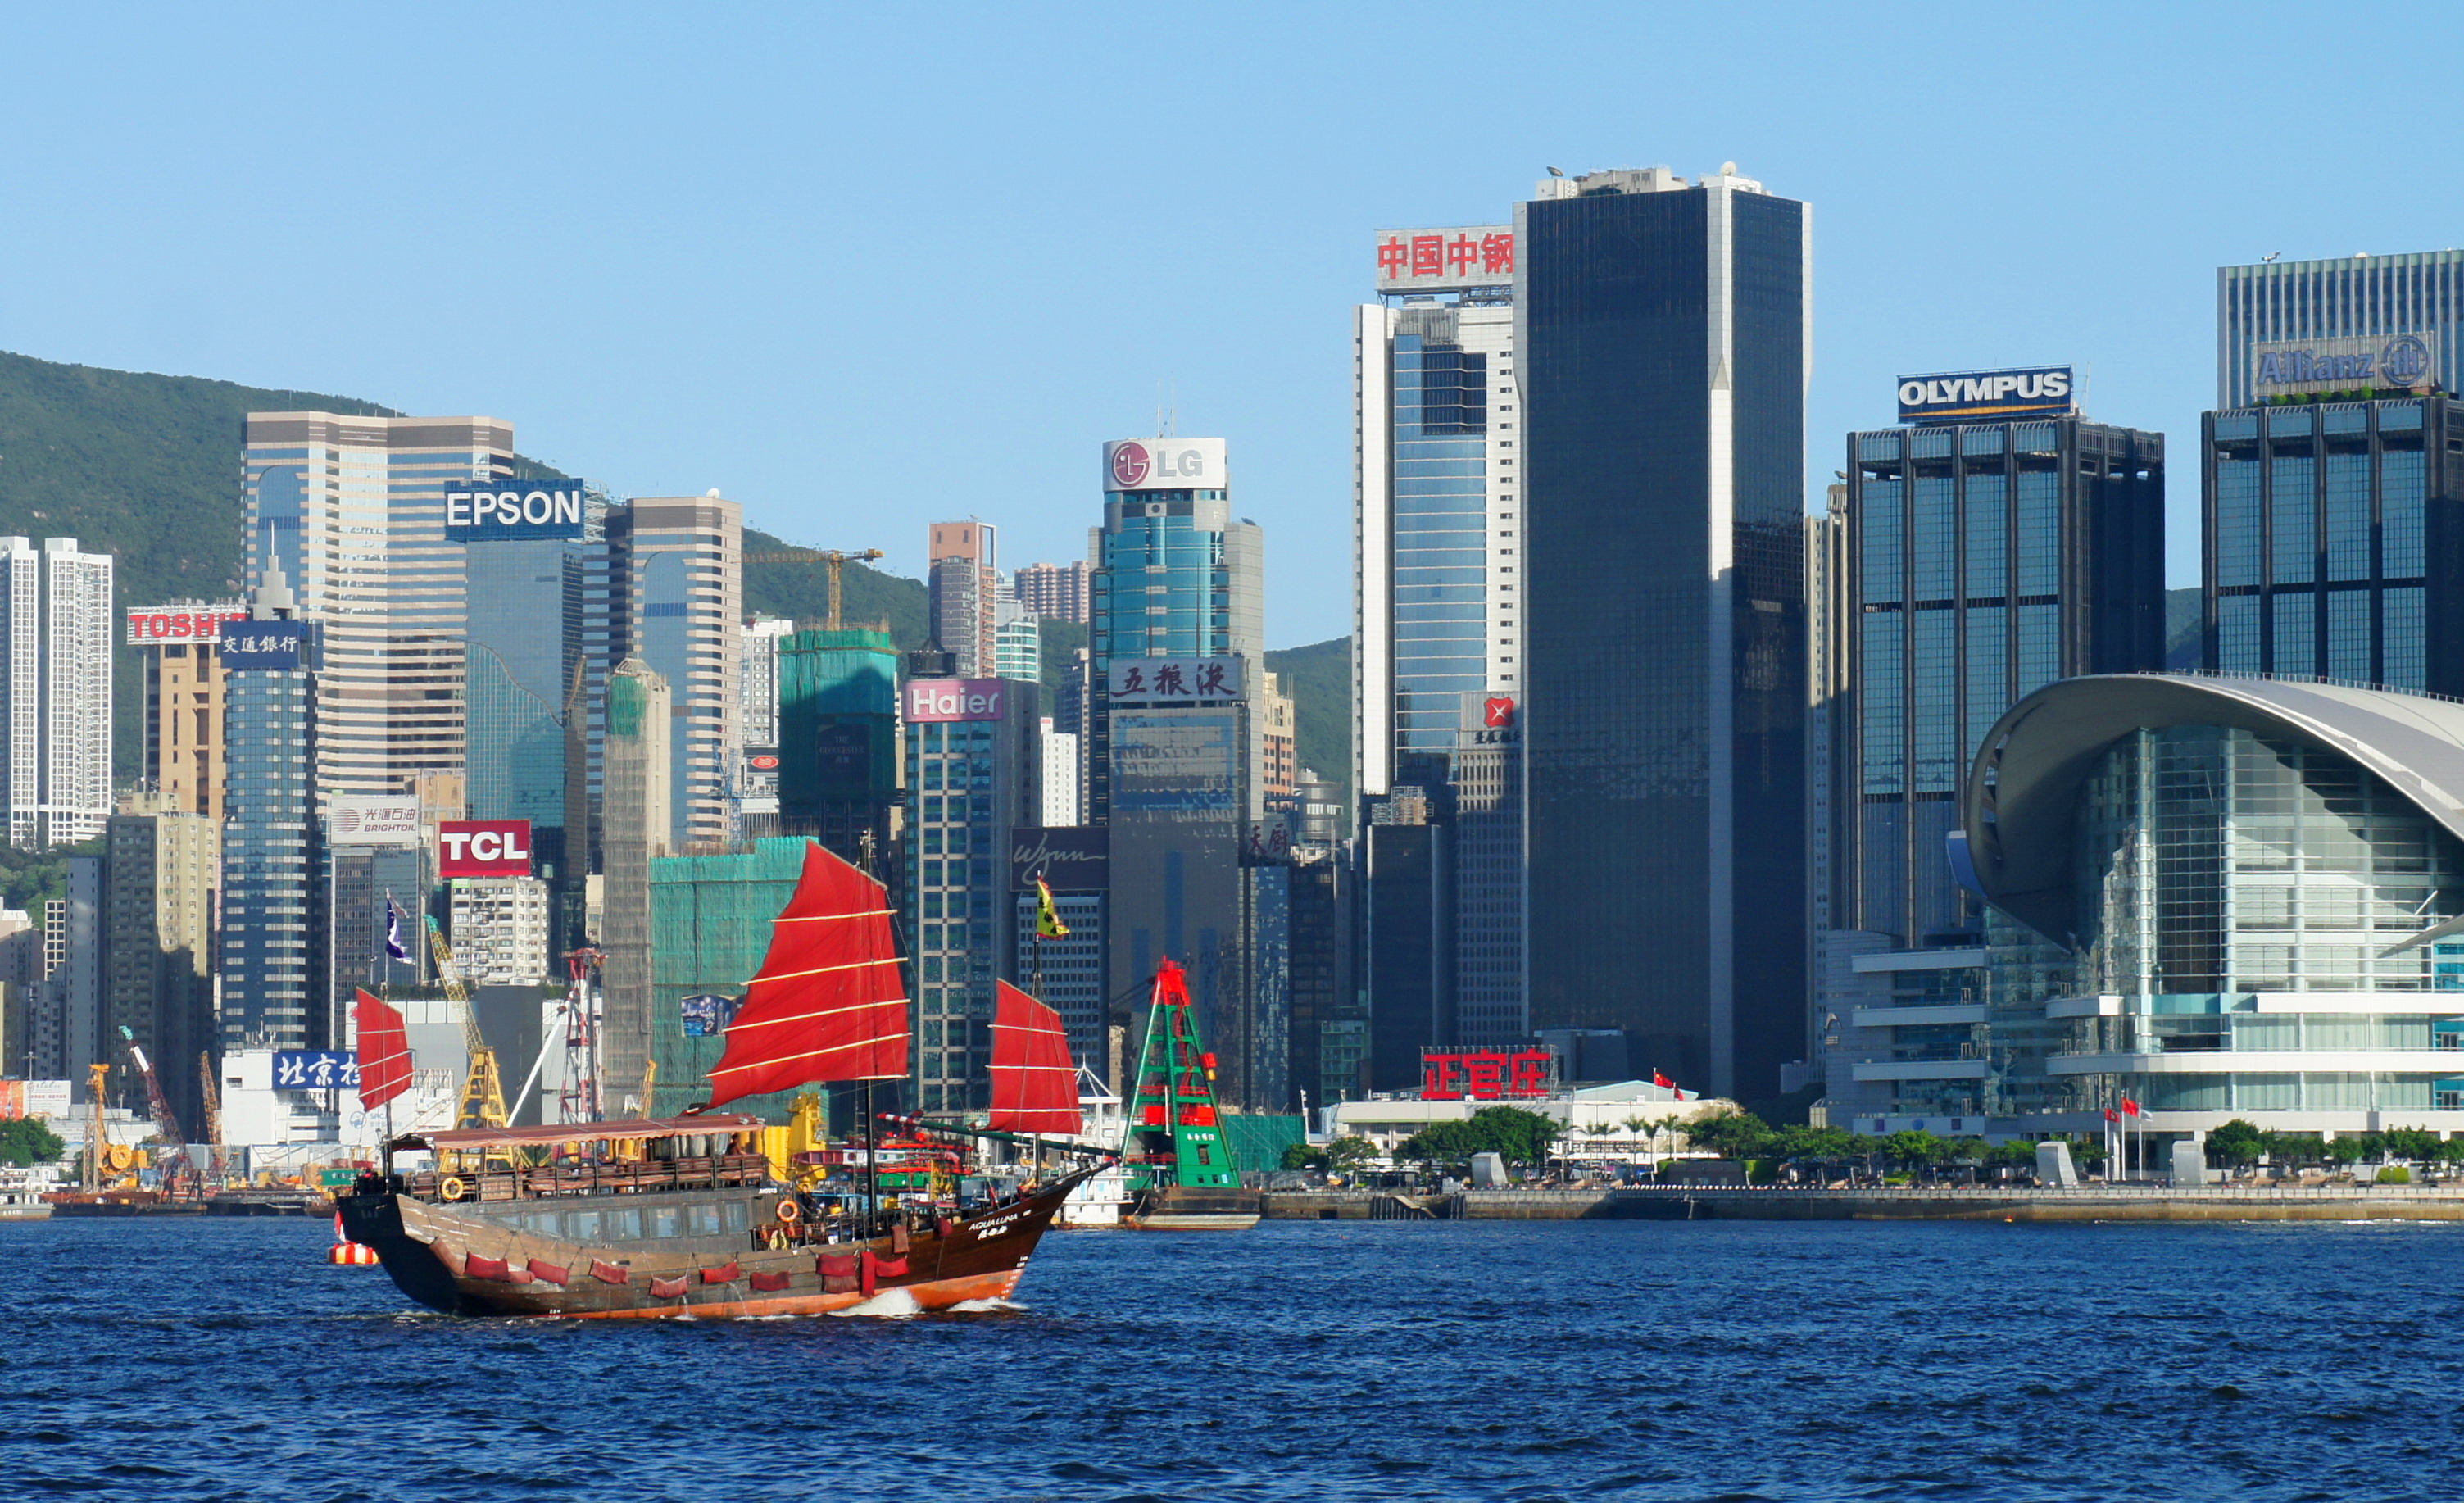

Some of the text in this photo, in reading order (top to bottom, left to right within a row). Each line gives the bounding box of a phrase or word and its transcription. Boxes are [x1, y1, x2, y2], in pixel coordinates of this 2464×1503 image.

[1377, 233, 1514, 279] 中国中钢
[2258, 349, 2375, 384] Allianz
[1899, 372, 2069, 406] OLYMPUS
[1157, 450, 1203, 477] LG
[447, 490, 579, 526] EPSON
[128, 612, 247, 638] TOSH
[222, 635, 298, 654] 交通銀行
[1109, 661, 1237, 697] 五粮液
[912, 688, 999, 715] Haier
[364, 824, 416, 833] BRIGHTOIL
[440, 831, 528, 861] TCL
[1421, 1048, 1550, 1100] 正官庄
